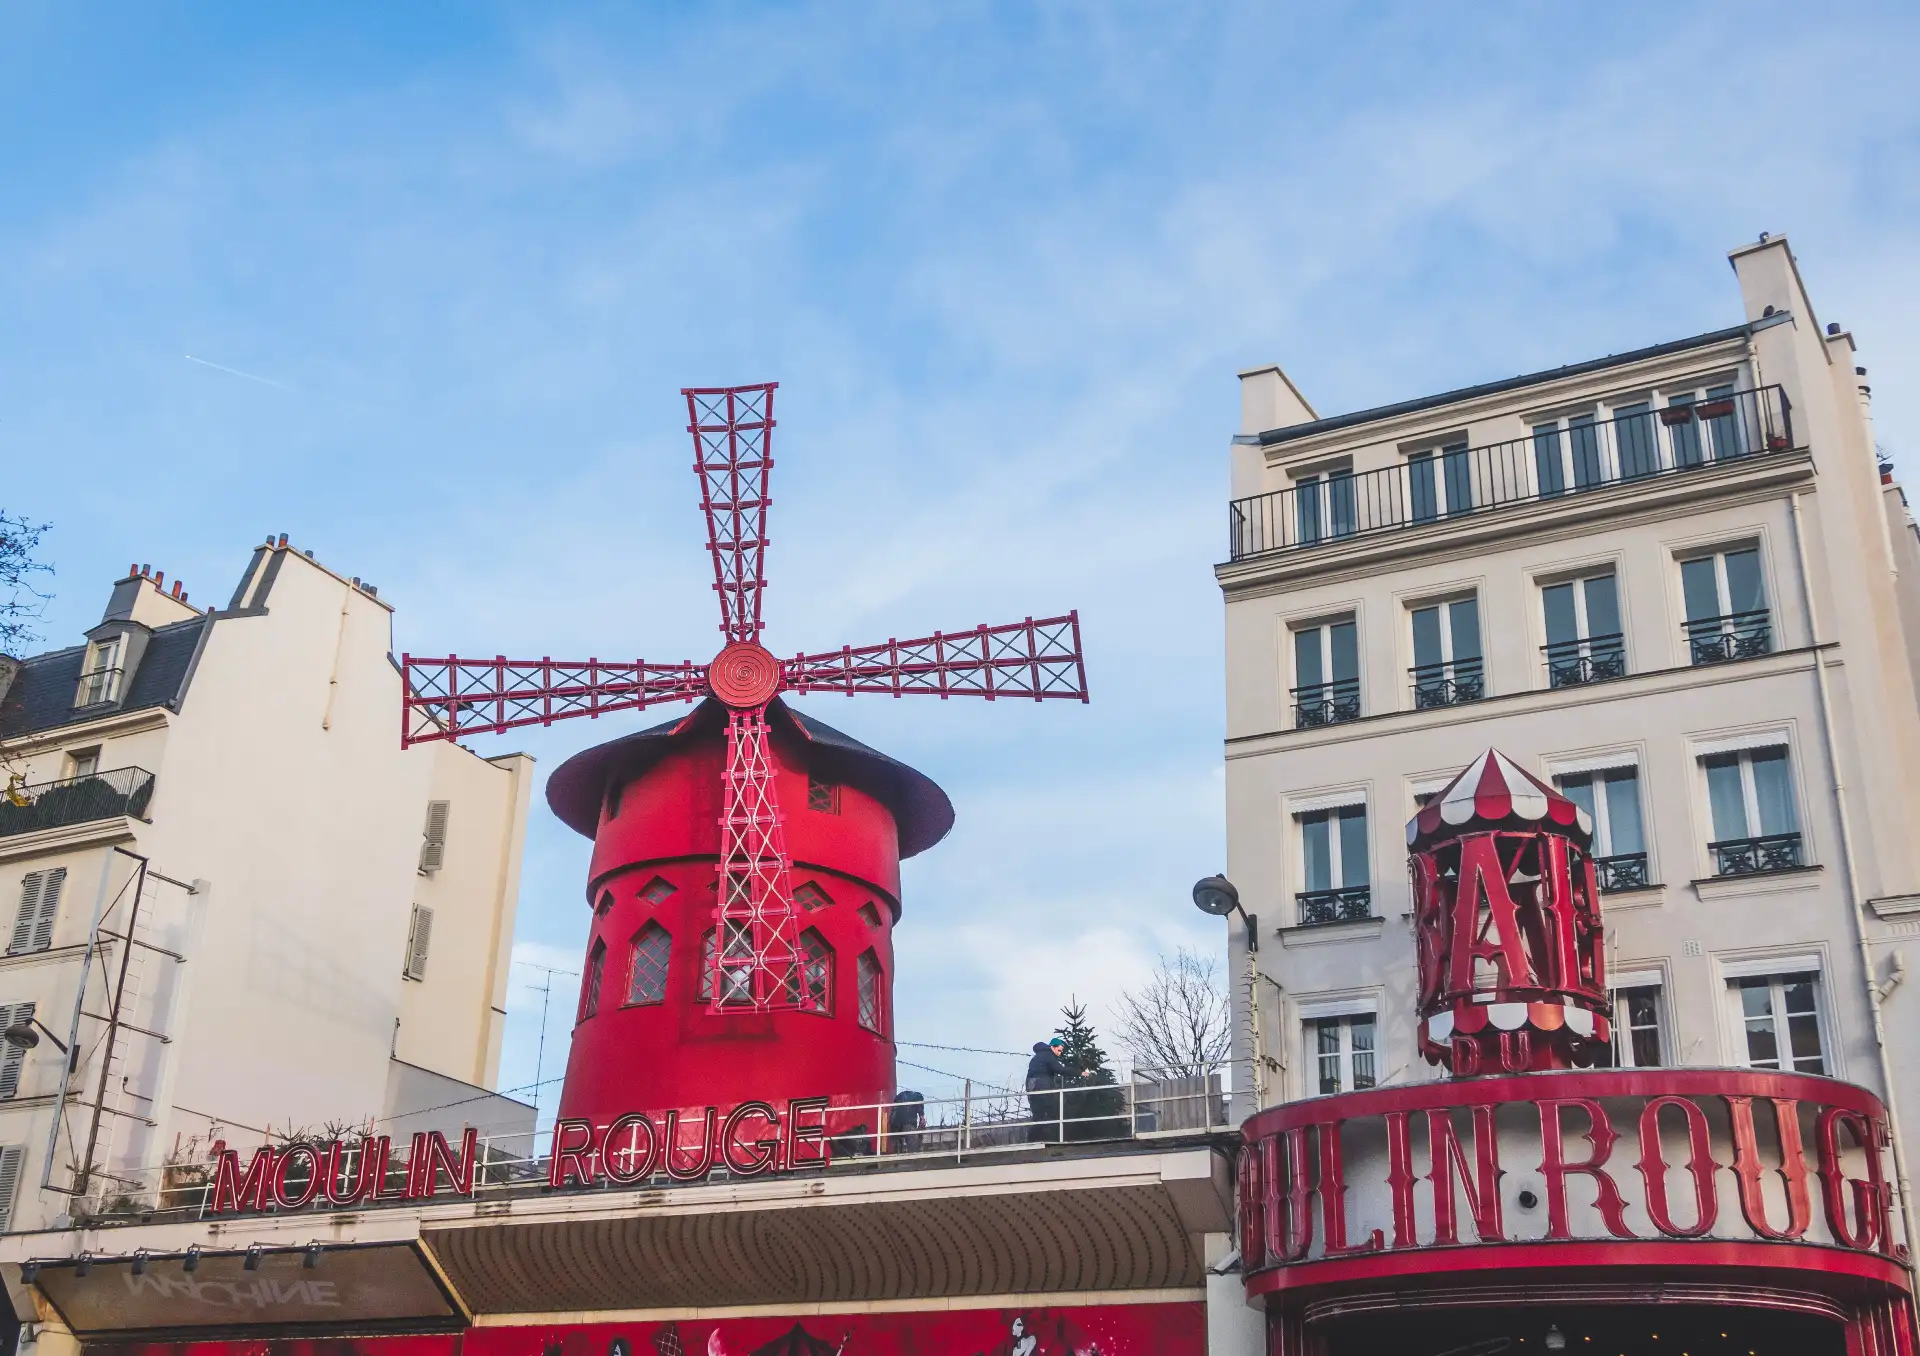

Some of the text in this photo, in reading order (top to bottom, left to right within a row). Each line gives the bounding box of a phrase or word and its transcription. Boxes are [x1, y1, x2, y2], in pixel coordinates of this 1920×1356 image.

[1451, 1030, 1531, 1077] DU
[210, 1096, 831, 1214] MOULIN ROUGE
